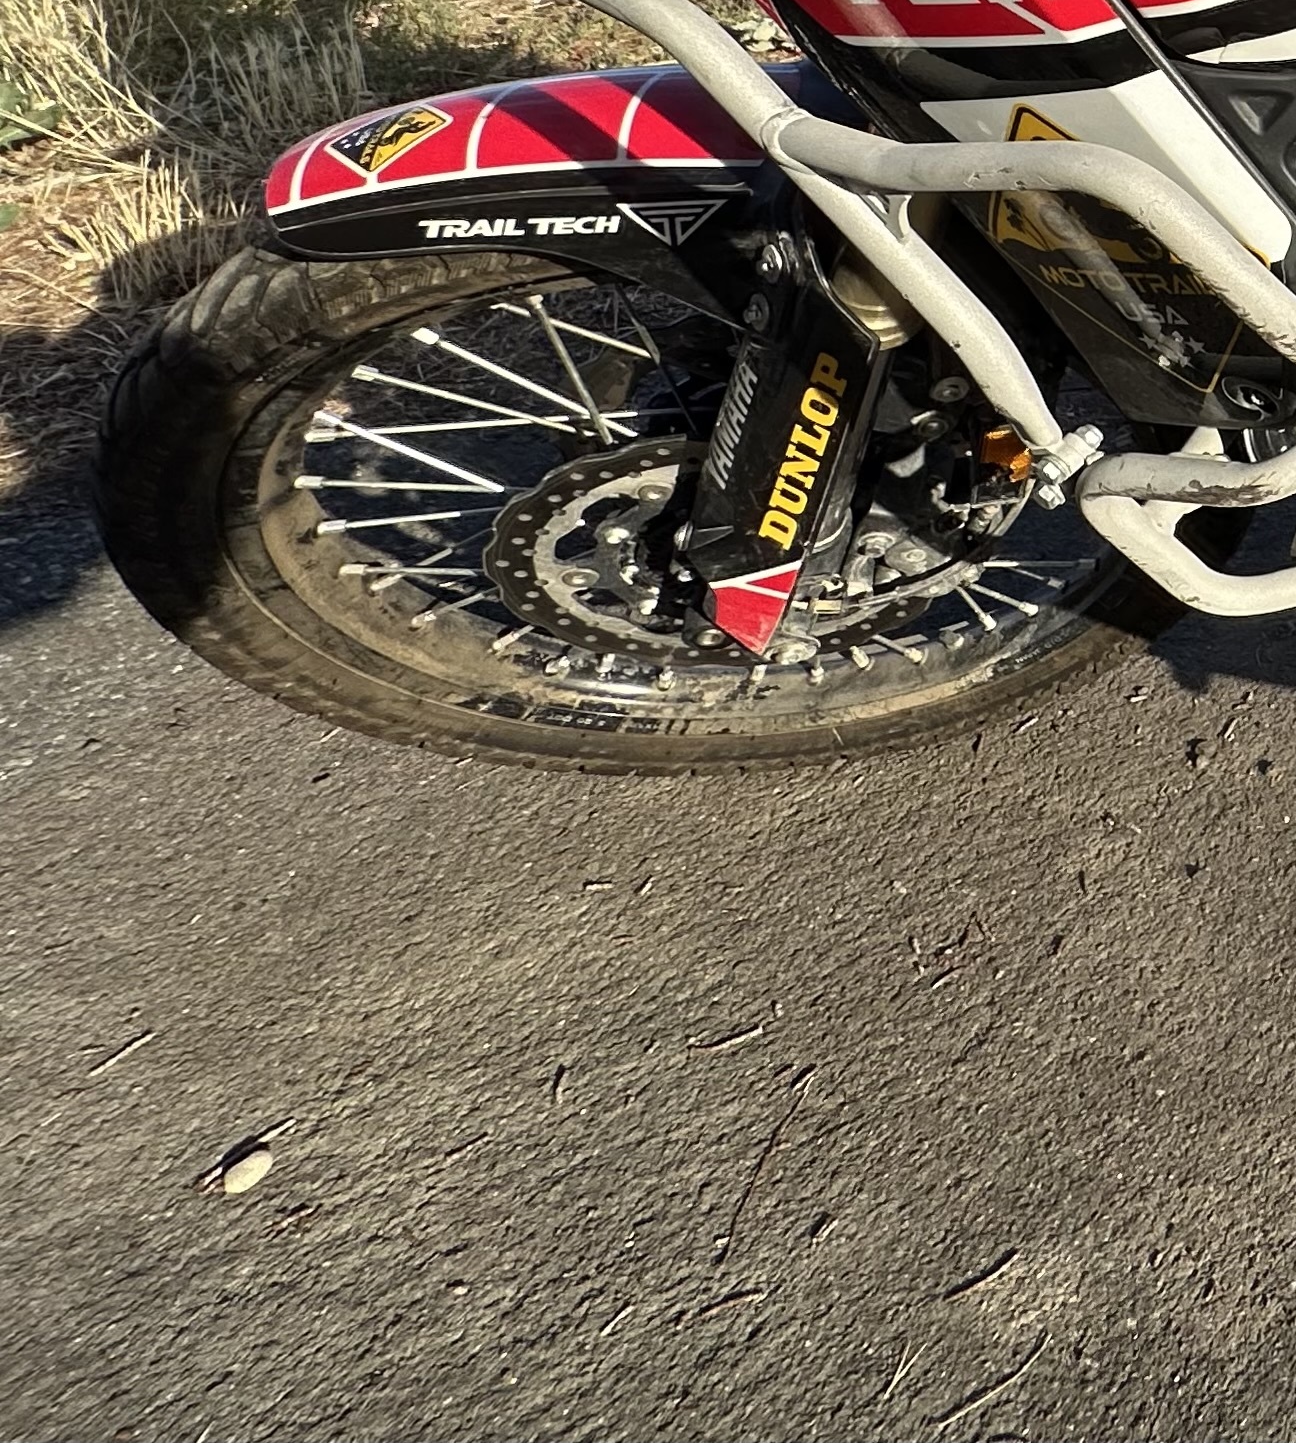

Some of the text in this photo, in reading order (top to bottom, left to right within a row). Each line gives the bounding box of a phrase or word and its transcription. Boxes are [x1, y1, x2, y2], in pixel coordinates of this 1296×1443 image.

[418, 215, 622, 239] TRAIL TECH
[1039, 264, 1217, 296] MOTO TRAIL
[1114, 301, 1190, 326] USA
[708, 353, 758, 490] YAMAHA
[758, 352, 847, 551] DUNLOP
